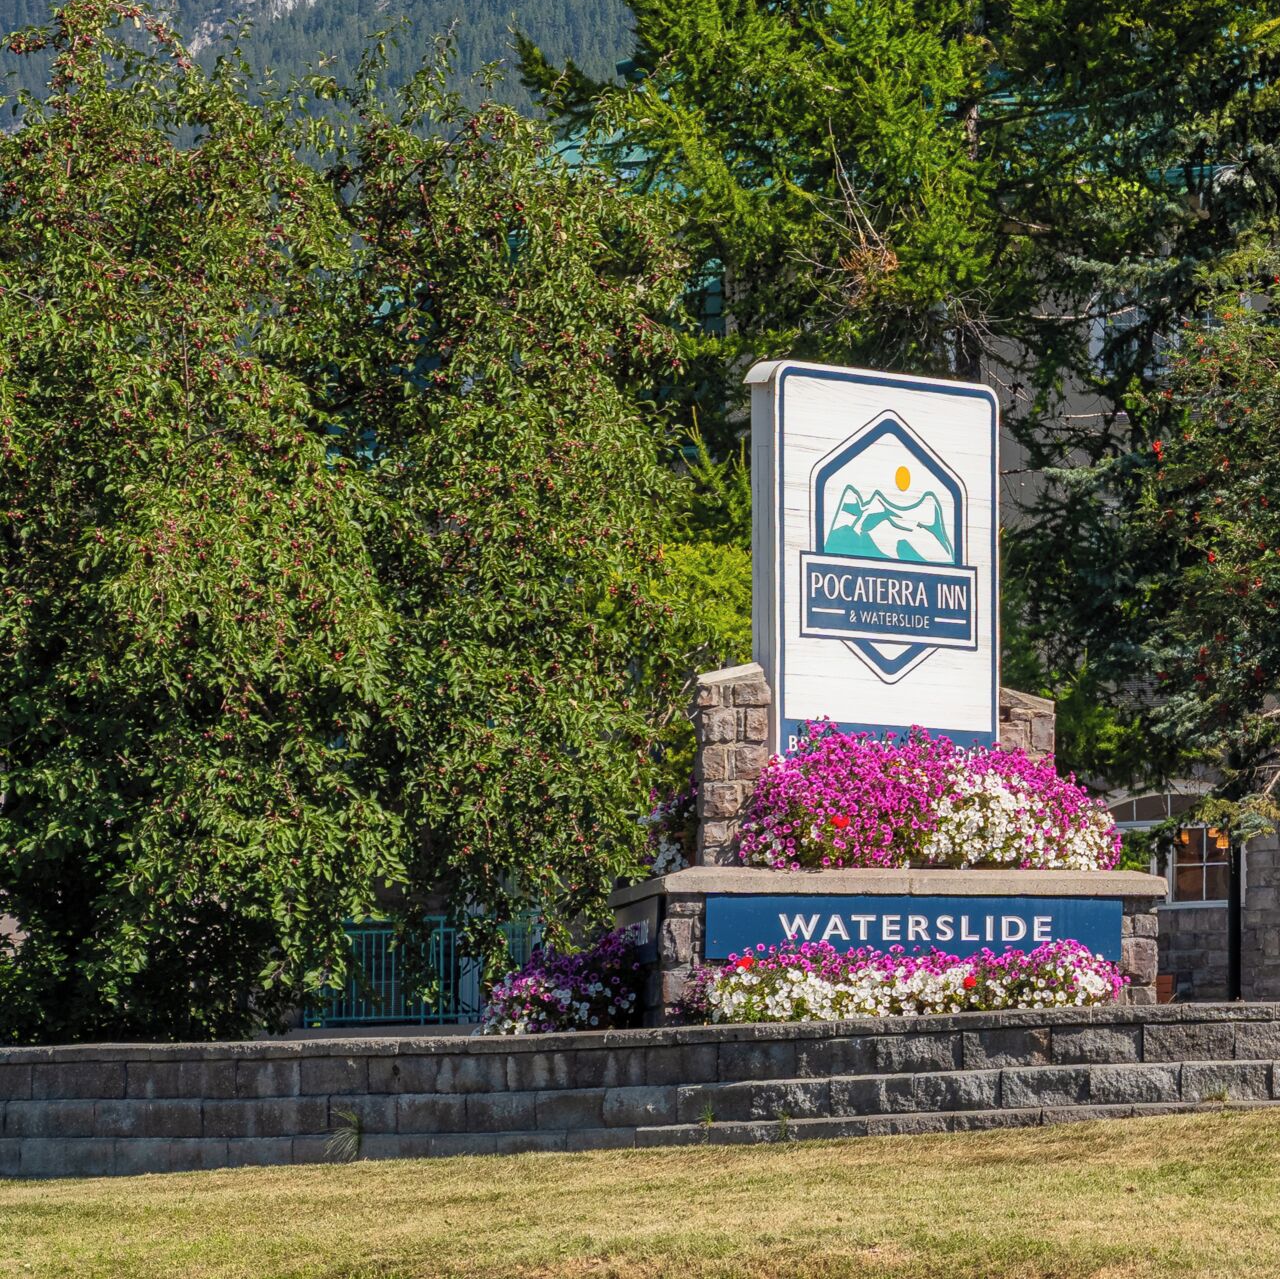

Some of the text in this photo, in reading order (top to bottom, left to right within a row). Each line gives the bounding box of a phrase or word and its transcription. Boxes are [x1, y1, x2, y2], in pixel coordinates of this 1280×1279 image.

[811, 572, 967, 610] POCATERRA INN
[850, 610, 930, 628] & WATERSLIDE
[778, 913, 1053, 942] WATERSLIDE
